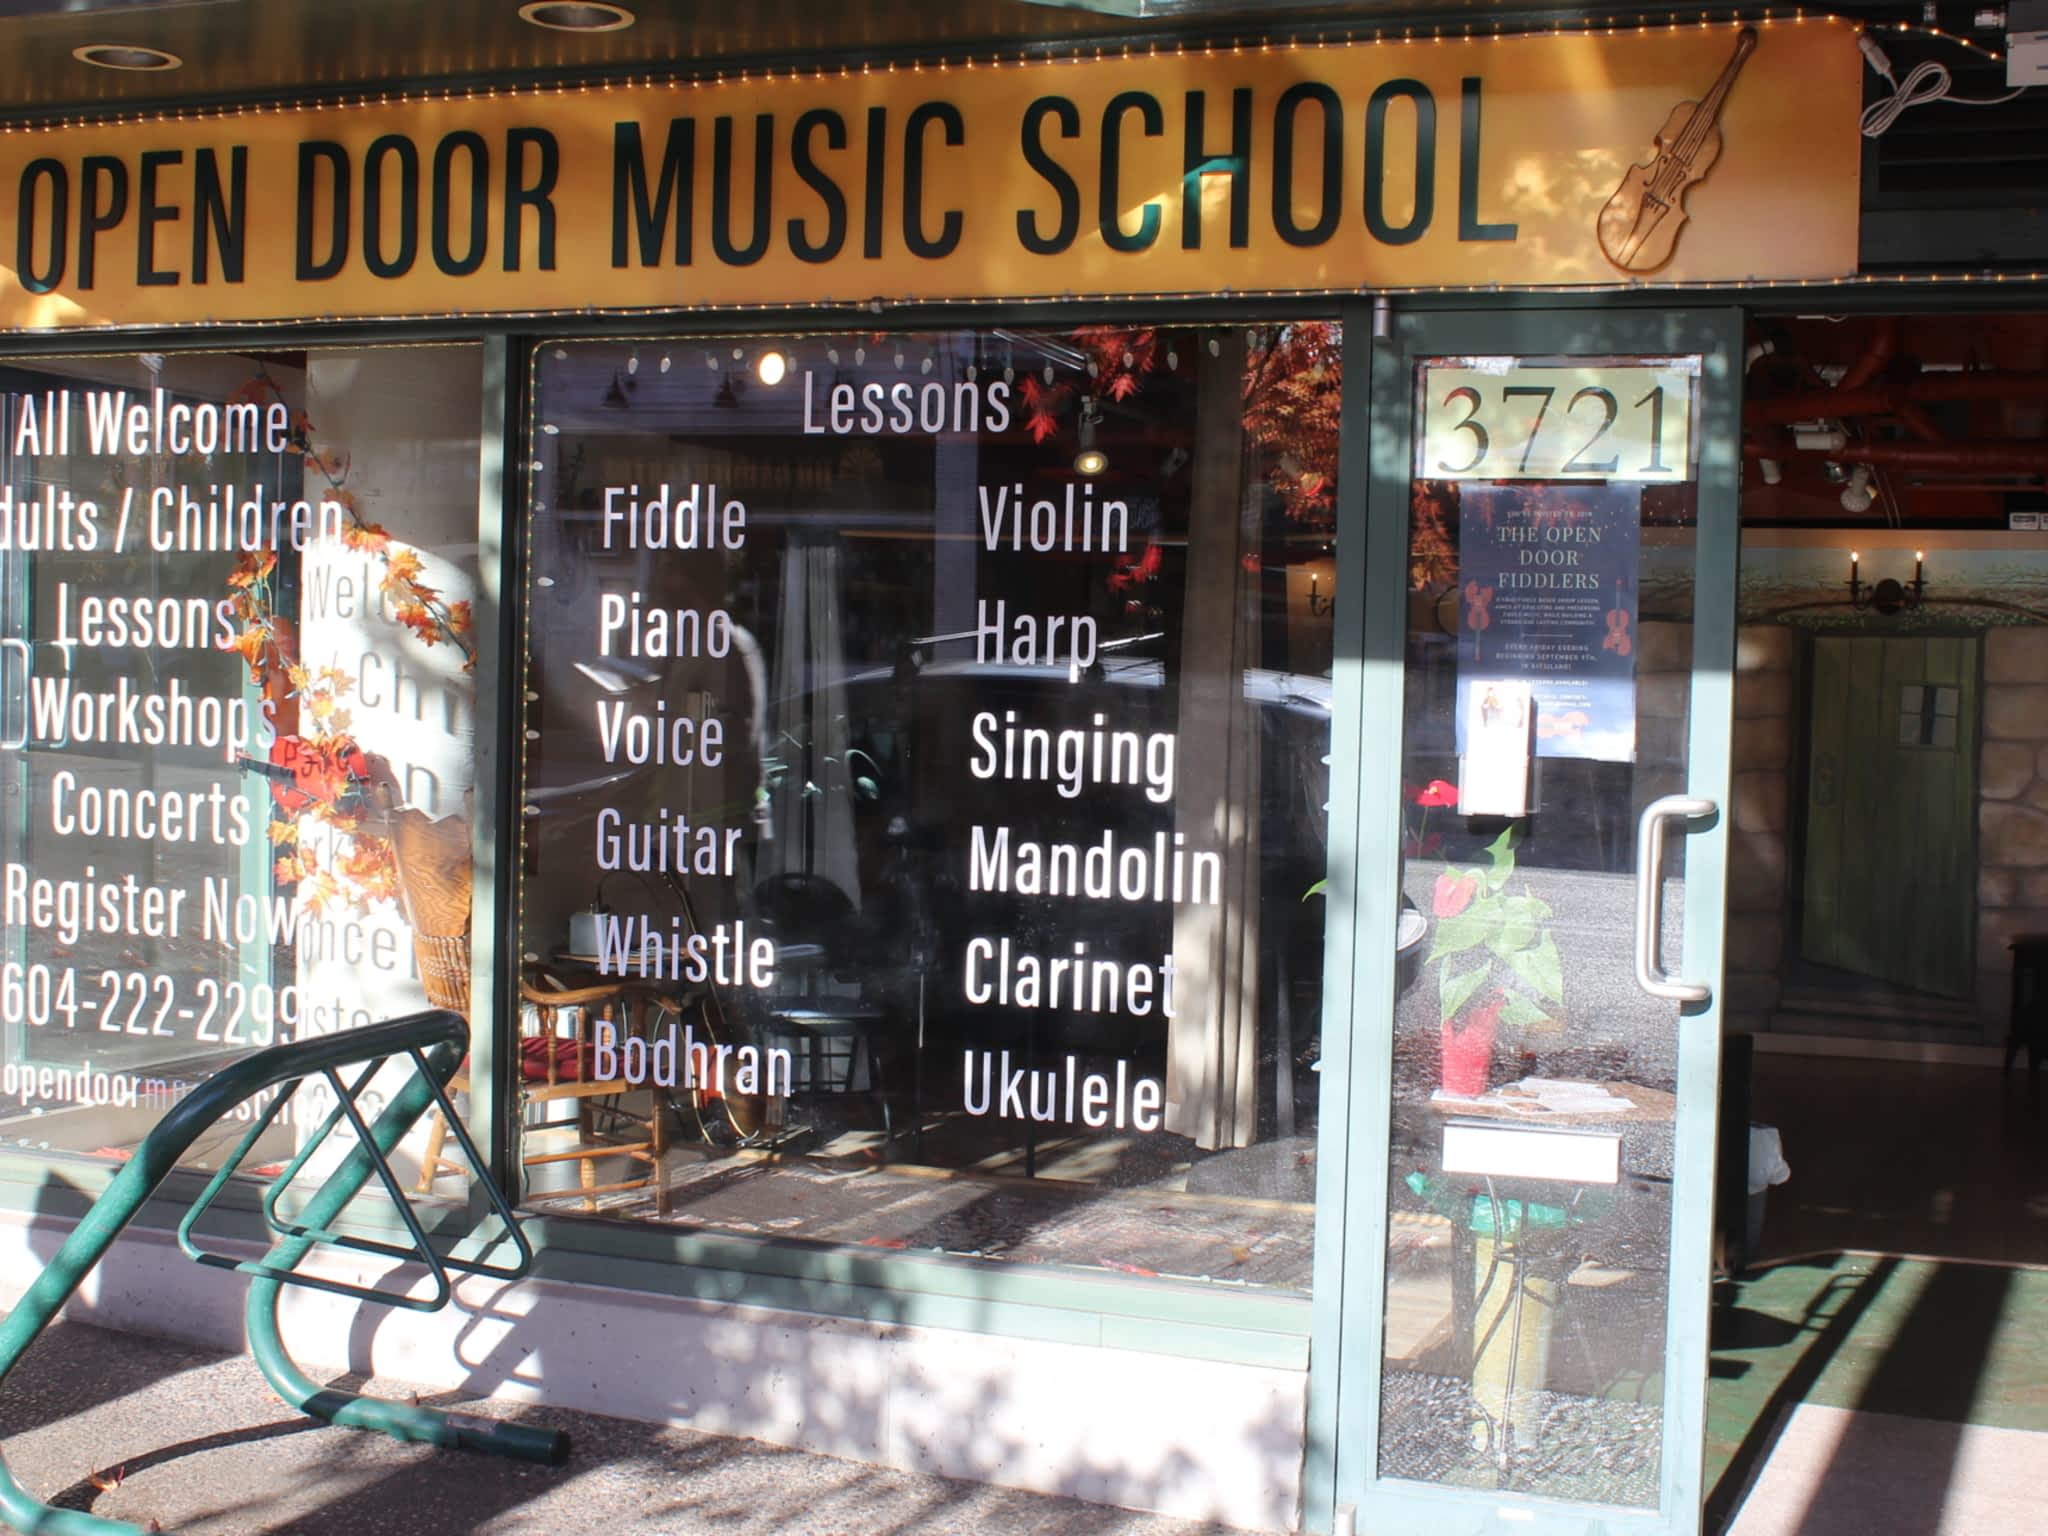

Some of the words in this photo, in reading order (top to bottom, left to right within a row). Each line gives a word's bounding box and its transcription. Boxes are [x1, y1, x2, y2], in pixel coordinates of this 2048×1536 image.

[17, 145, 248, 295] OPEN
[295, 127, 560, 281] DOOR
[611, 101, 965, 268] MUSIC
[1016, 77, 1518, 255] SCHOOL
[15, 389, 69, 456] All
[86, 387, 289, 455] Welcome
[803, 370, 1010, 434] Lessons
[1437, 385, 1673, 473] 3721
[148, 484, 344, 554] Children
[602, 483, 747, 550] Fiddle
[979, 483, 1129, 553] Violin
[1496, 526, 1538, 543] THE
[1546, 526, 1601, 543] OPEN
[1499, 572, 1599, 589] FIDDLERS
[1520, 549, 1579, 566] DOOR
[57, 581, 236, 650] Lessons
[600, 591, 733, 659] Piano
[976, 599, 1098, 684] Harp
[31, 676, 277, 763] Workshops
[596, 699, 724, 767] Voice
[970, 711, 1176, 802] Singing
[51, 769, 251, 847] Concerts
[595, 807, 741, 877] Guitar
[970, 826, 1222, 905] Mandolin
[5, 863, 186, 945] Register
[203, 876, 300, 945] Now
[595, 914, 775, 989] Whistle
[964, 937, 1178, 1018] Clarinet
[2, 962, 299, 1046] 604-222-2299
[594, 1020, 793, 1097] Bodhran
[964, 1049, 1163, 1132] Ukulele
